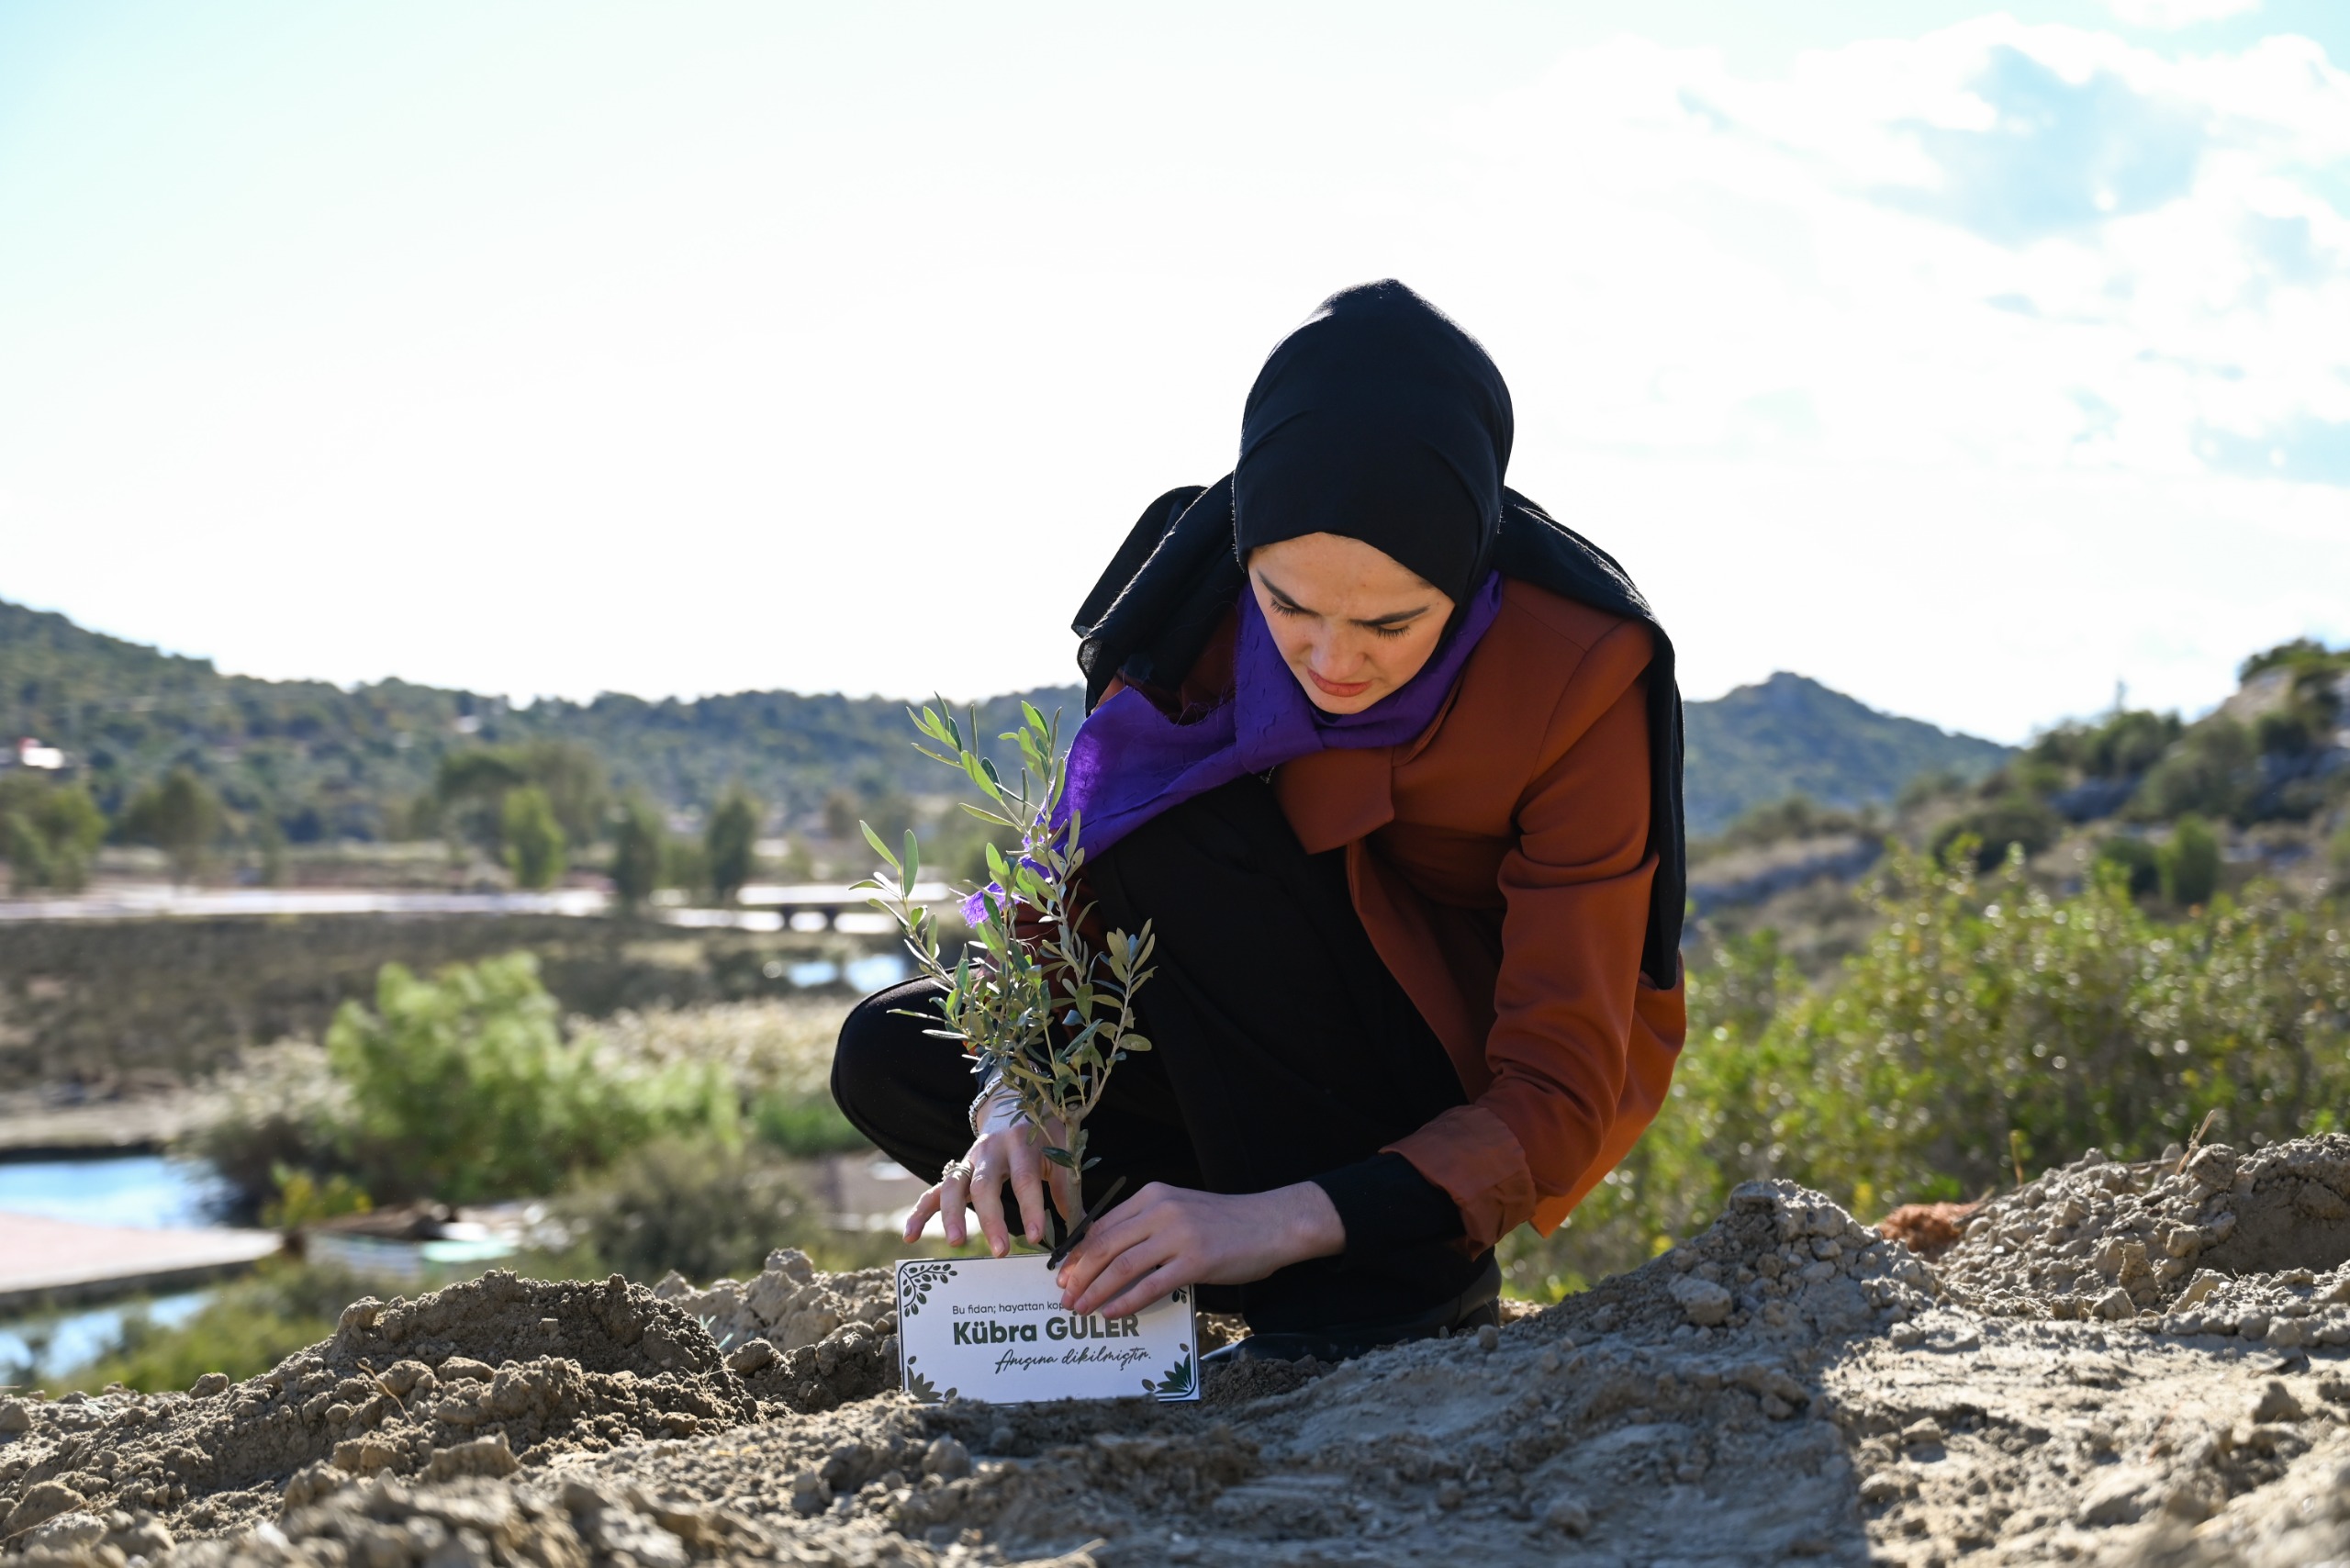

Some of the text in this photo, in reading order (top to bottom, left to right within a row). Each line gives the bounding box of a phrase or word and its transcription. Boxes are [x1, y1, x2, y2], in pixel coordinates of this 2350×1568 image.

[952, 1301, 1066, 1315] Bu fidan; hayattan kop
[953, 1311, 1140, 1346] Kübra GÜLER
